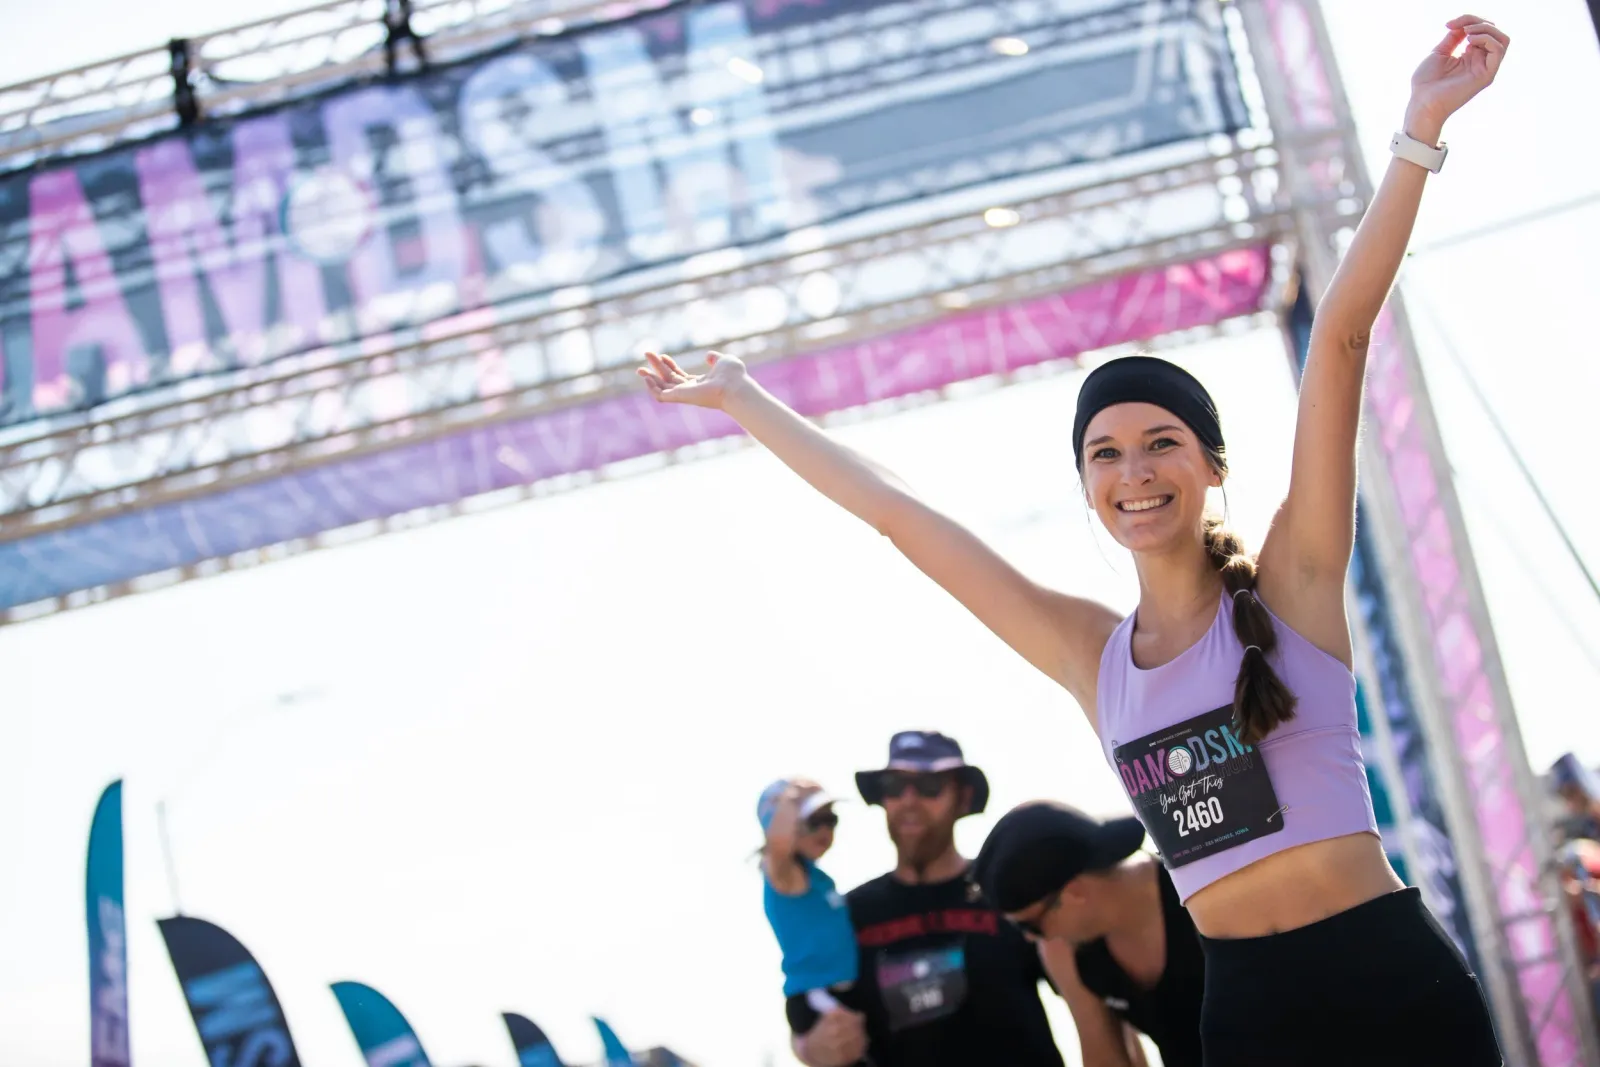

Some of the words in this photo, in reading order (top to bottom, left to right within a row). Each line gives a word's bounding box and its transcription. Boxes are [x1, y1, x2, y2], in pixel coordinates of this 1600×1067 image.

[1120, 747, 1174, 797] DAM
[1159, 792, 1178, 814] You
[1178, 781, 1201, 807] Got
[1198, 774, 1224, 795] This
[1173, 796, 1224, 837] 2460
